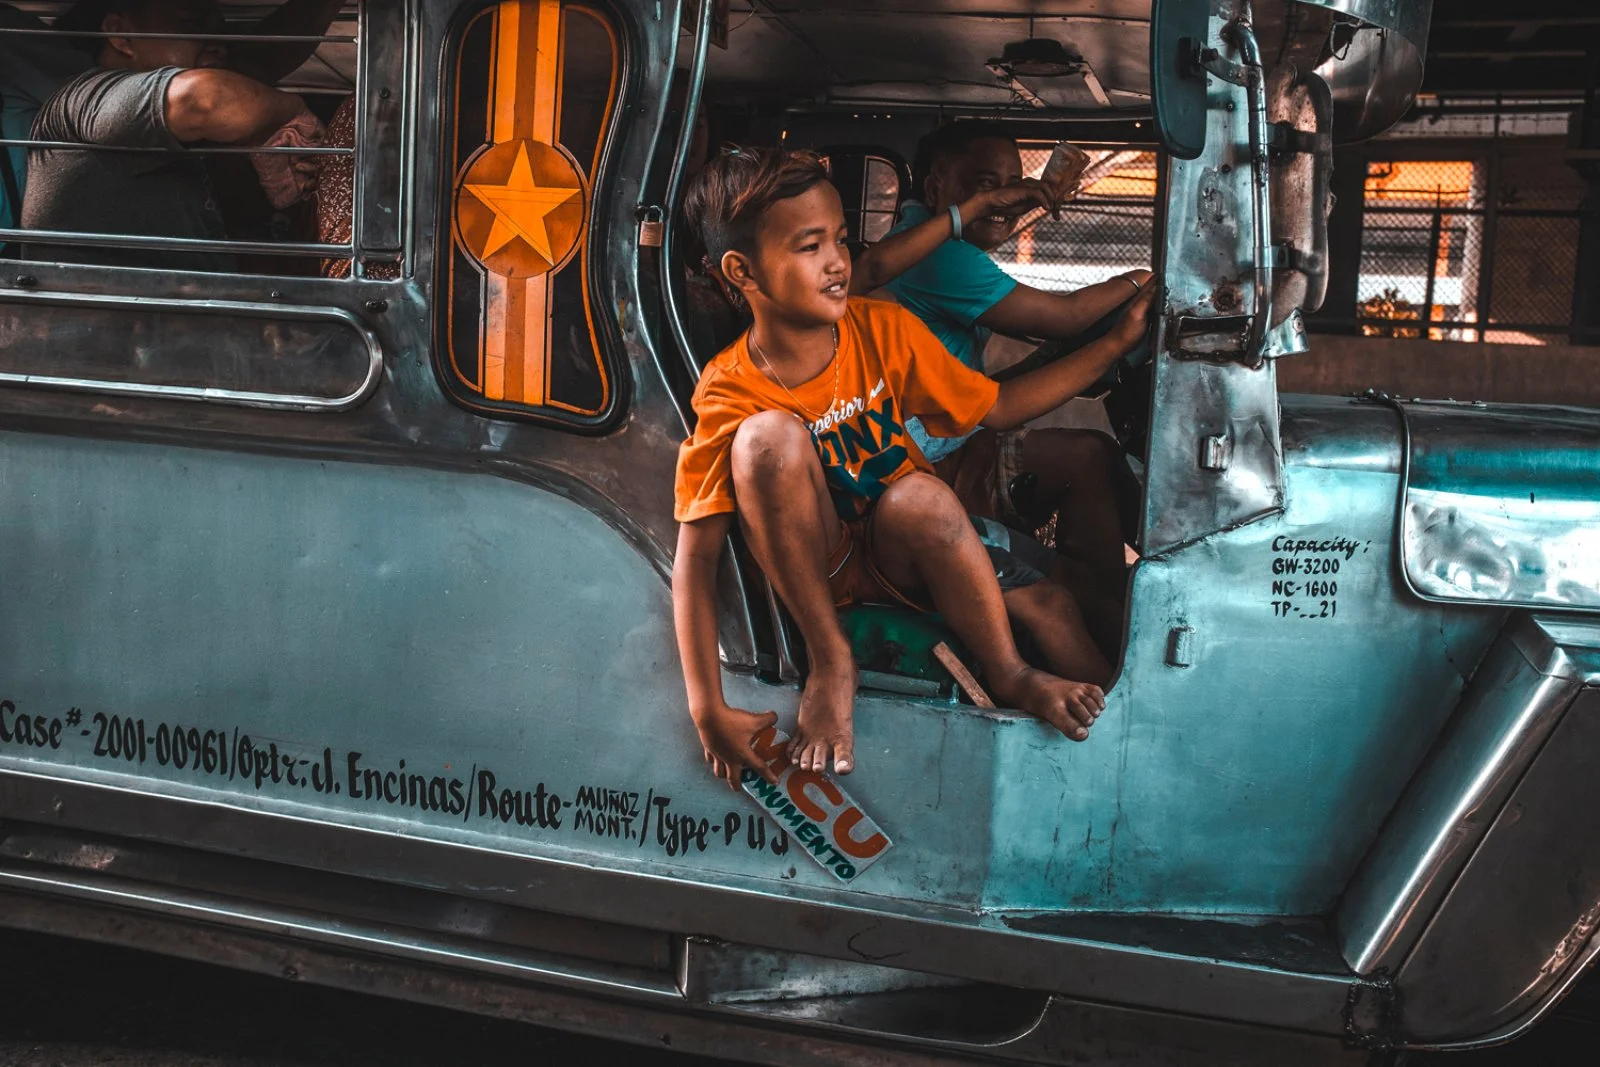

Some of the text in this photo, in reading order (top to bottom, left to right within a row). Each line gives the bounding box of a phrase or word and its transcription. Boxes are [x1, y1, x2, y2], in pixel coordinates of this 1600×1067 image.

[808, 396, 865, 437] perior
[1272, 557, 1340, 575] GW-3200
[1272, 580, 1338, 597] NC-1600
[574, 808, 637, 840] MONT.
[742, 768, 856, 879] ONUMENTO
